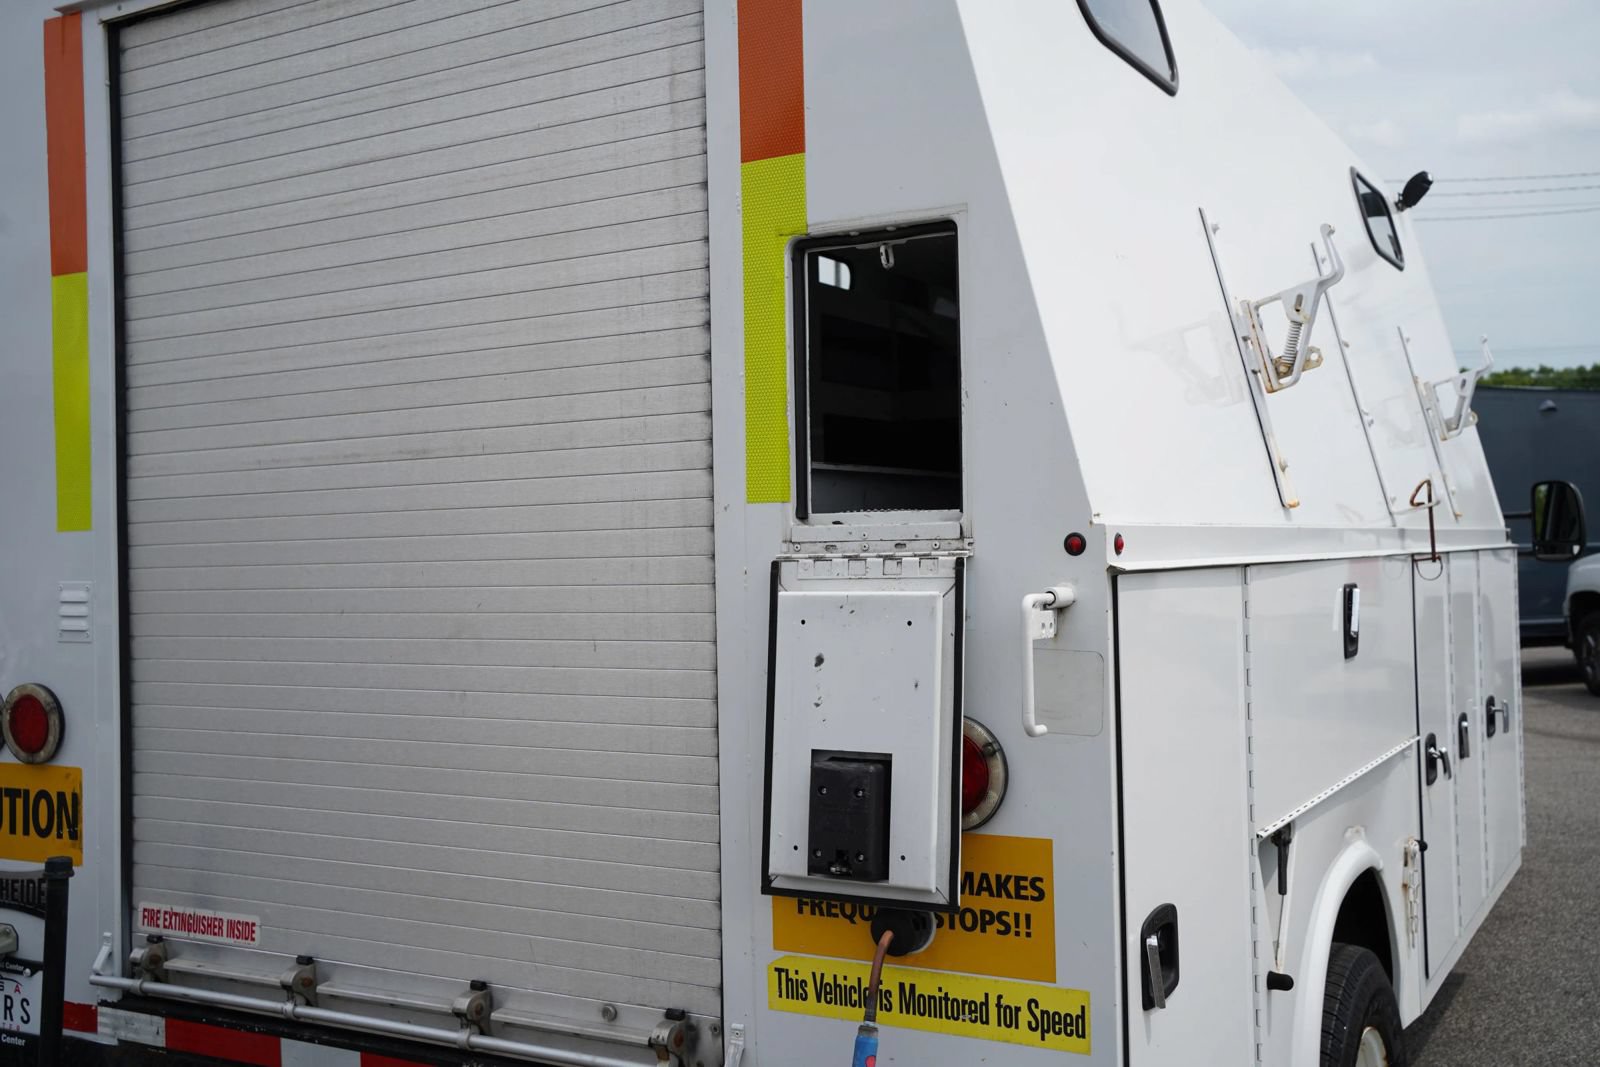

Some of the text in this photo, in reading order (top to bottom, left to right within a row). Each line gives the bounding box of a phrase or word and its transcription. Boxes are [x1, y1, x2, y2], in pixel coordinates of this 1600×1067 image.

[0, 787, 79, 840] TION
[960, 871, 1046, 902] MAKES
[142, 907, 256, 942] FIRE EXTINGUISHER INSIDE
[797, 897, 875, 924] FREQU
[774, 967, 808, 1001] This
[879, 979, 893, 1012] is
[898, 981, 990, 1026] Monitored
[995, 993, 1022, 1030] for
[1026, 998, 1087, 1042] Speed
[1, 1033, 26, 1047] Center
